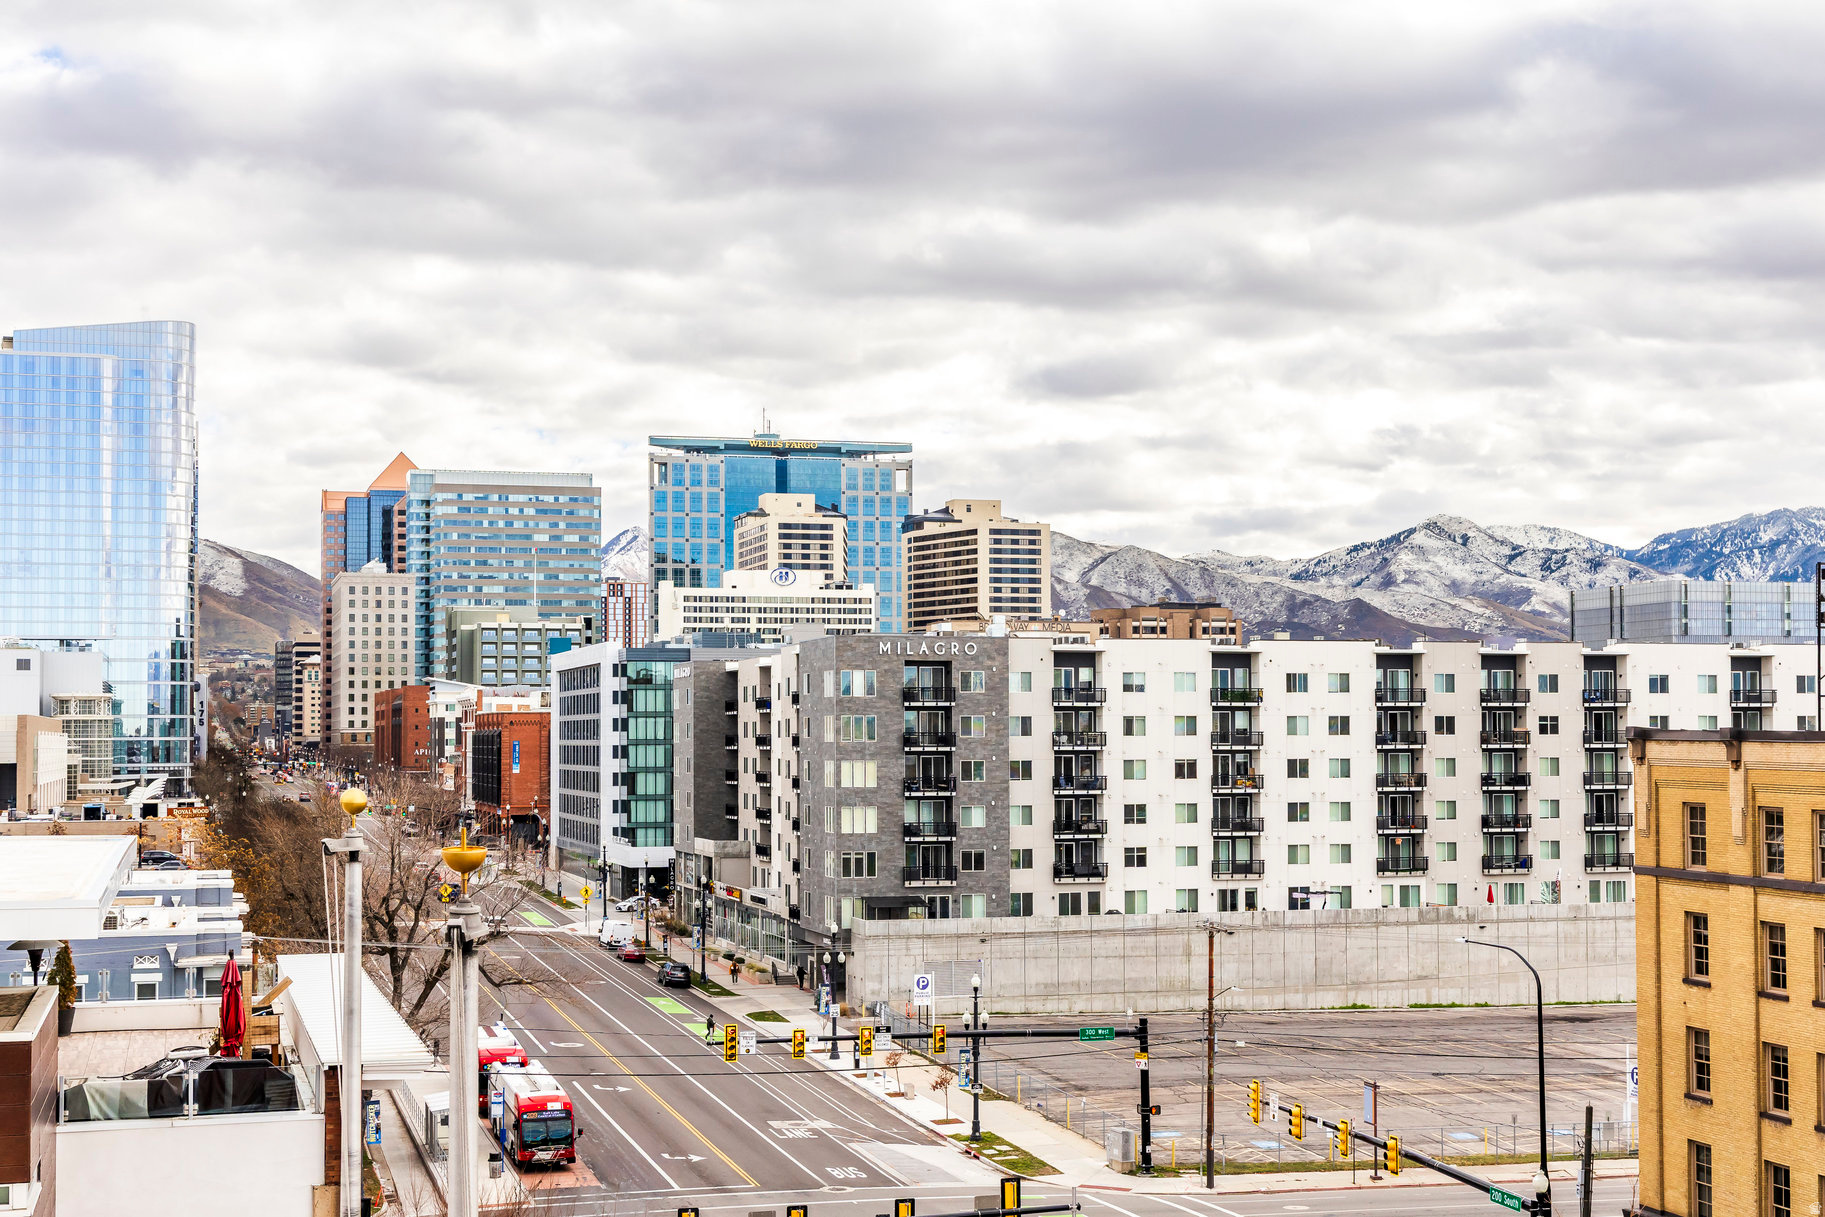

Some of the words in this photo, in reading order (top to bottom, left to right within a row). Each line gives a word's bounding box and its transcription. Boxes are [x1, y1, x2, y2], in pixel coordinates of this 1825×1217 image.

[749, 440, 783, 448] WELLS
[785, 441, 818, 450] FARGO
[1042, 622, 1072, 632] MEDIA
[879, 641, 978, 656] MILAGRO
[768, 1128, 819, 1139] LANE
[825, 1166, 868, 1179] BUS
[1492, 1190, 1502, 1202] 200
[1504, 1195, 1518, 1208] South
